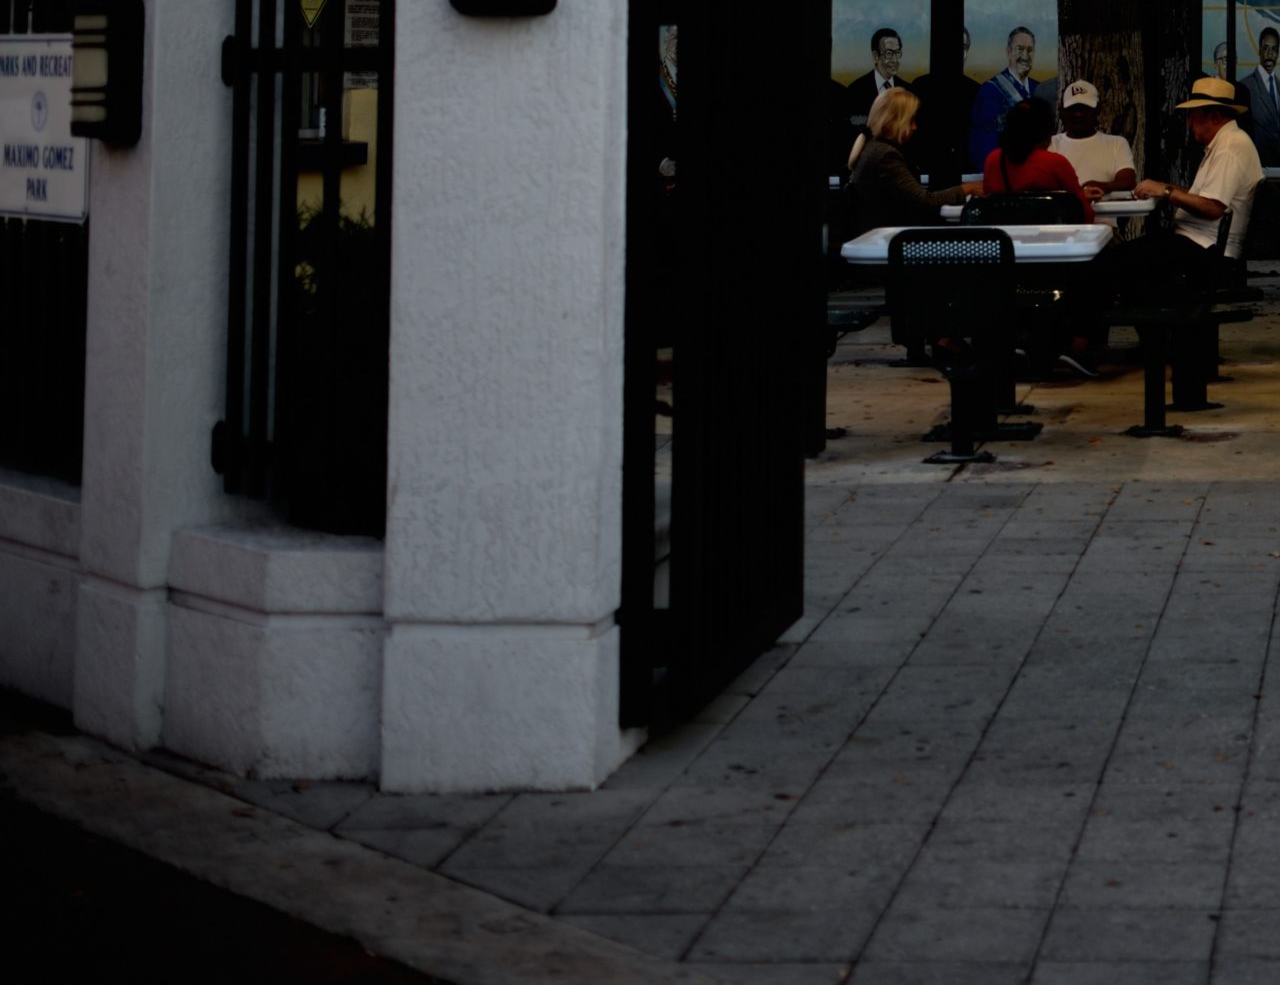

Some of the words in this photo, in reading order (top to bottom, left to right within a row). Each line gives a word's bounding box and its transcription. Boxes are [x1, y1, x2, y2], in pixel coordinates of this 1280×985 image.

[0, 55, 20, 77] ARKS
[22, 55, 37, 77] AND
[40, 55, 72, 77] RECREAT
[4, 144, 39, 168] MAXIMO
[42, 145, 74, 170] GOMEZ
[26, 178, 47, 202] PARK
